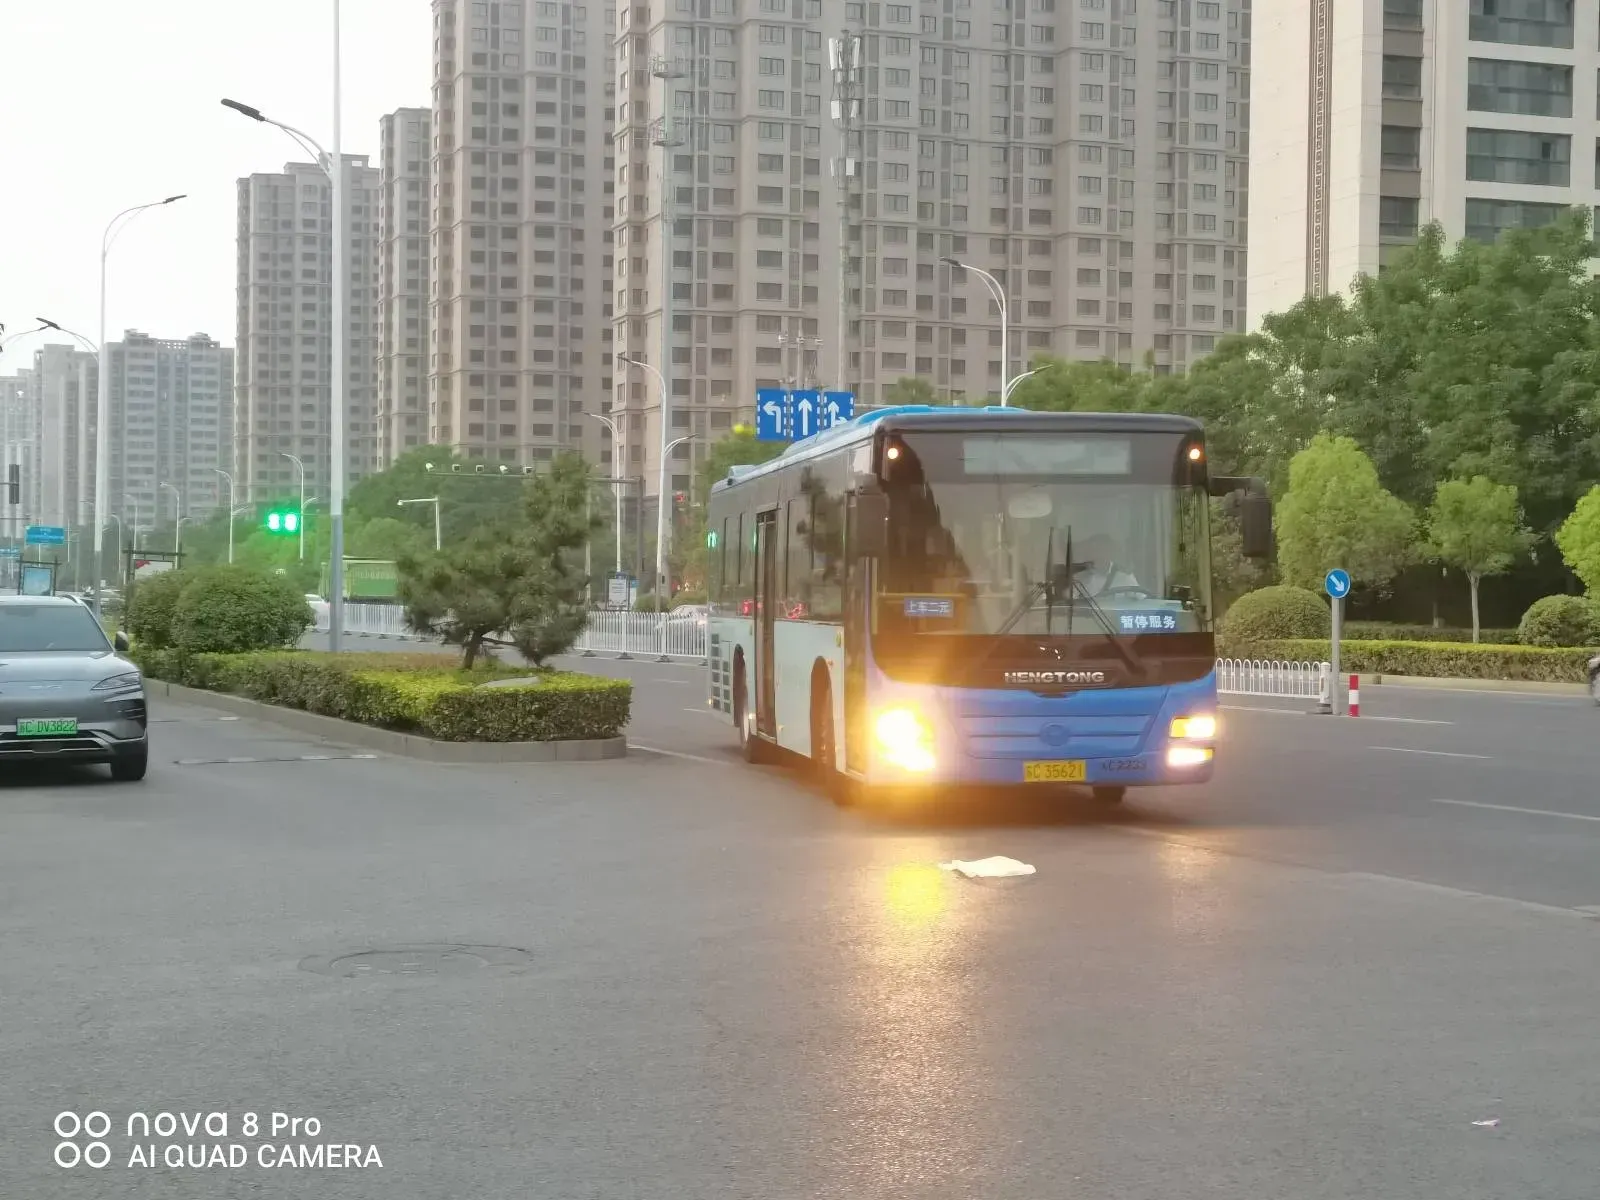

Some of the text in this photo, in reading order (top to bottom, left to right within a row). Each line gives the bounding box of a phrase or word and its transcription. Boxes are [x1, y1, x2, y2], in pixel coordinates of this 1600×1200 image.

[1120, 615, 1176, 629] 暂停服务
[1004, 671, 1105, 683] HENGTONG
